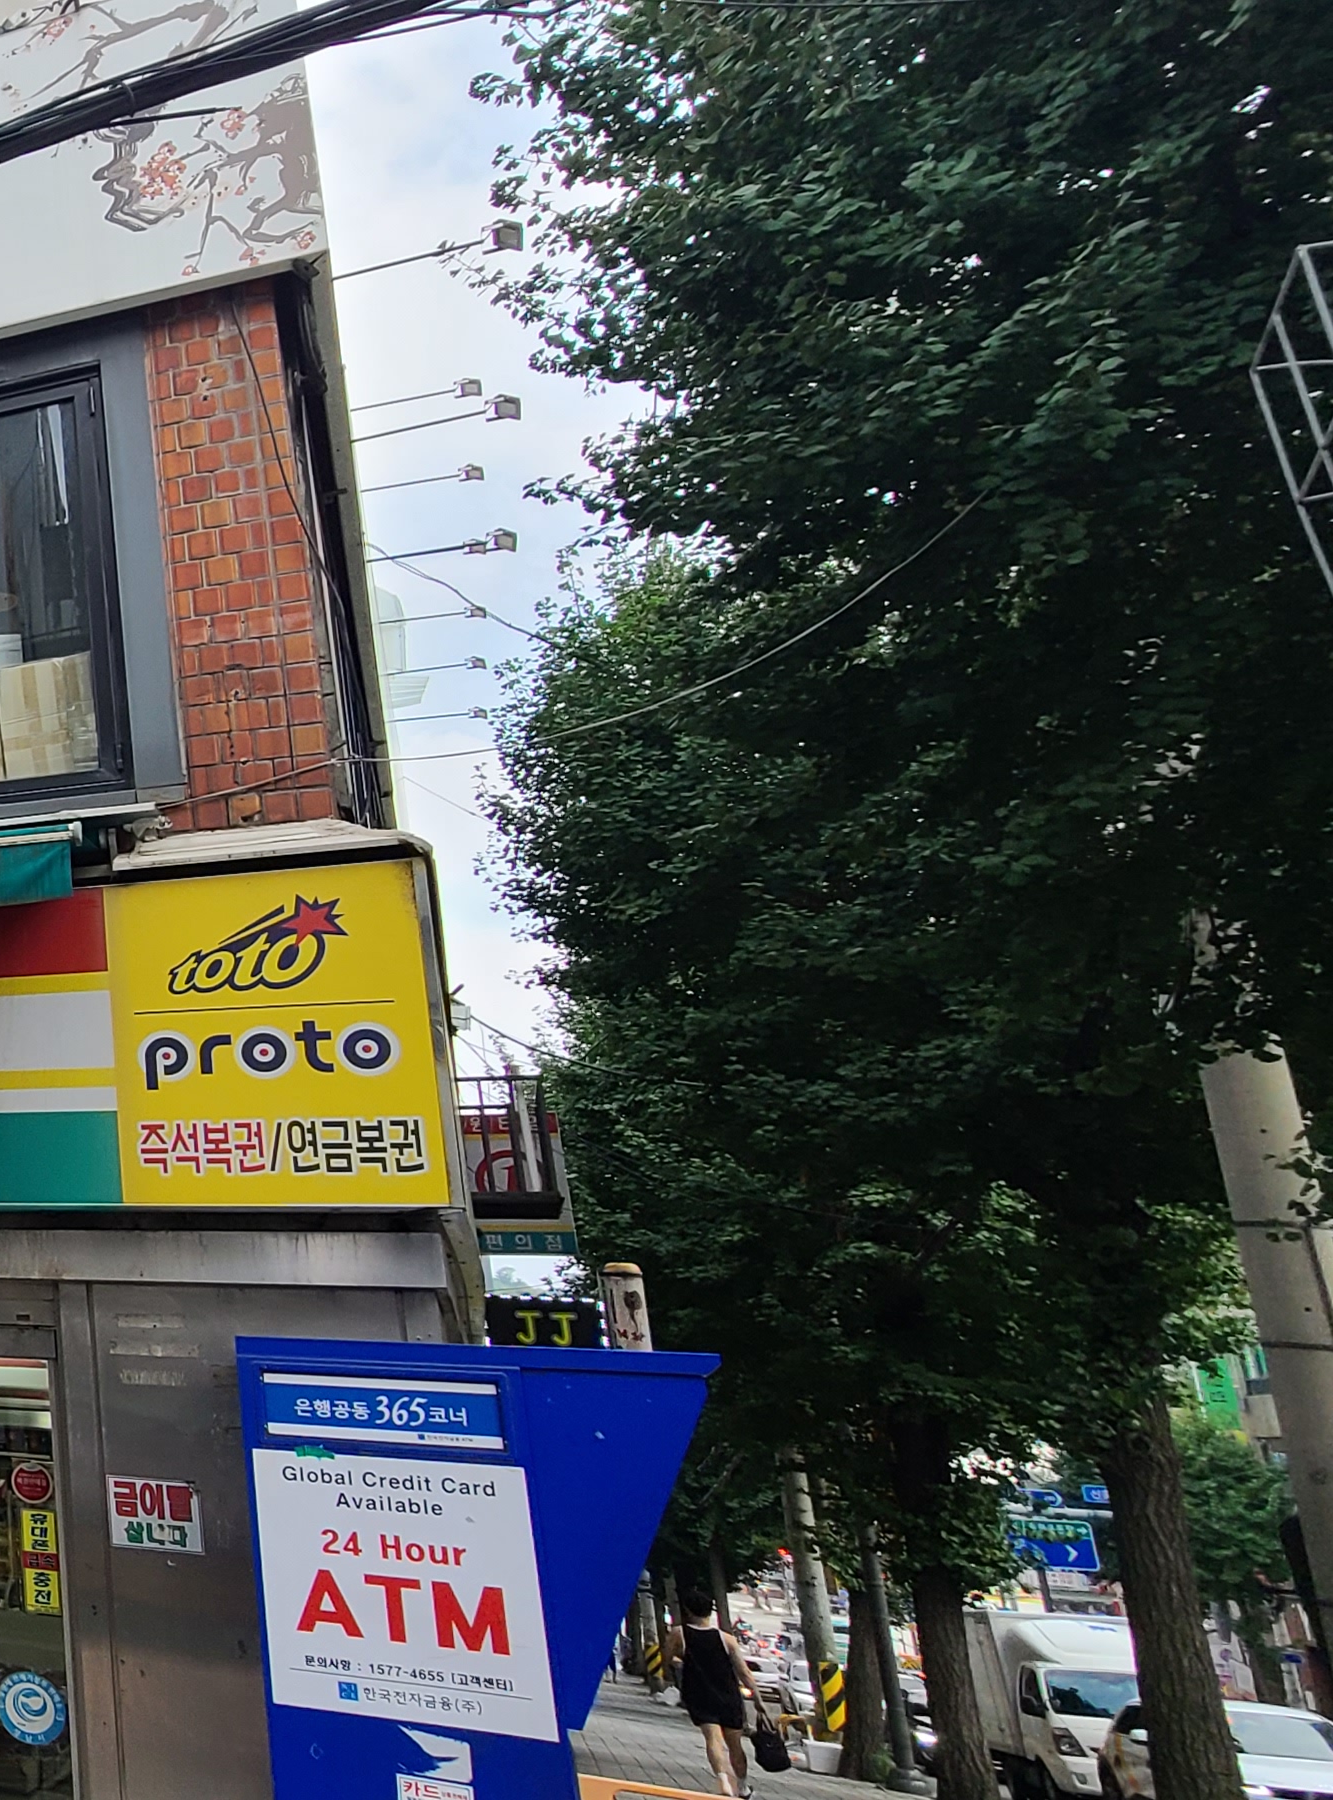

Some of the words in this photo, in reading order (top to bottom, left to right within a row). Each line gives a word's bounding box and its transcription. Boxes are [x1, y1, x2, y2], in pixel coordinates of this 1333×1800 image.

[167, 931, 330, 995] toto
[137, 1019, 400, 1091] proto
[485, 1233, 563, 1251] 편의점
[293, 1397, 372, 1422] 은행공동
[373, 1394, 430, 1428] 365
[428, 1407, 470, 1428] 코너
[281, 1465, 354, 1487] Global
[361, 1470, 433, 1493] Credit
[440, 1476, 497, 1498] Card
[335, 1493, 444, 1517] Available
[319, 1528, 364, 1559] 24
[379, 1533, 468, 1568] Hour
[32, 1570, 53, 1606] 충전
[296, 1567, 512, 1657] ATM
[303, 1654, 352, 1673] 문의사항
[368, 1662, 446, 1684] 1577-4655
[361, 1686, 484, 1717] 한국전자금융(주)
[402, 1780, 442, 1800] 카드
